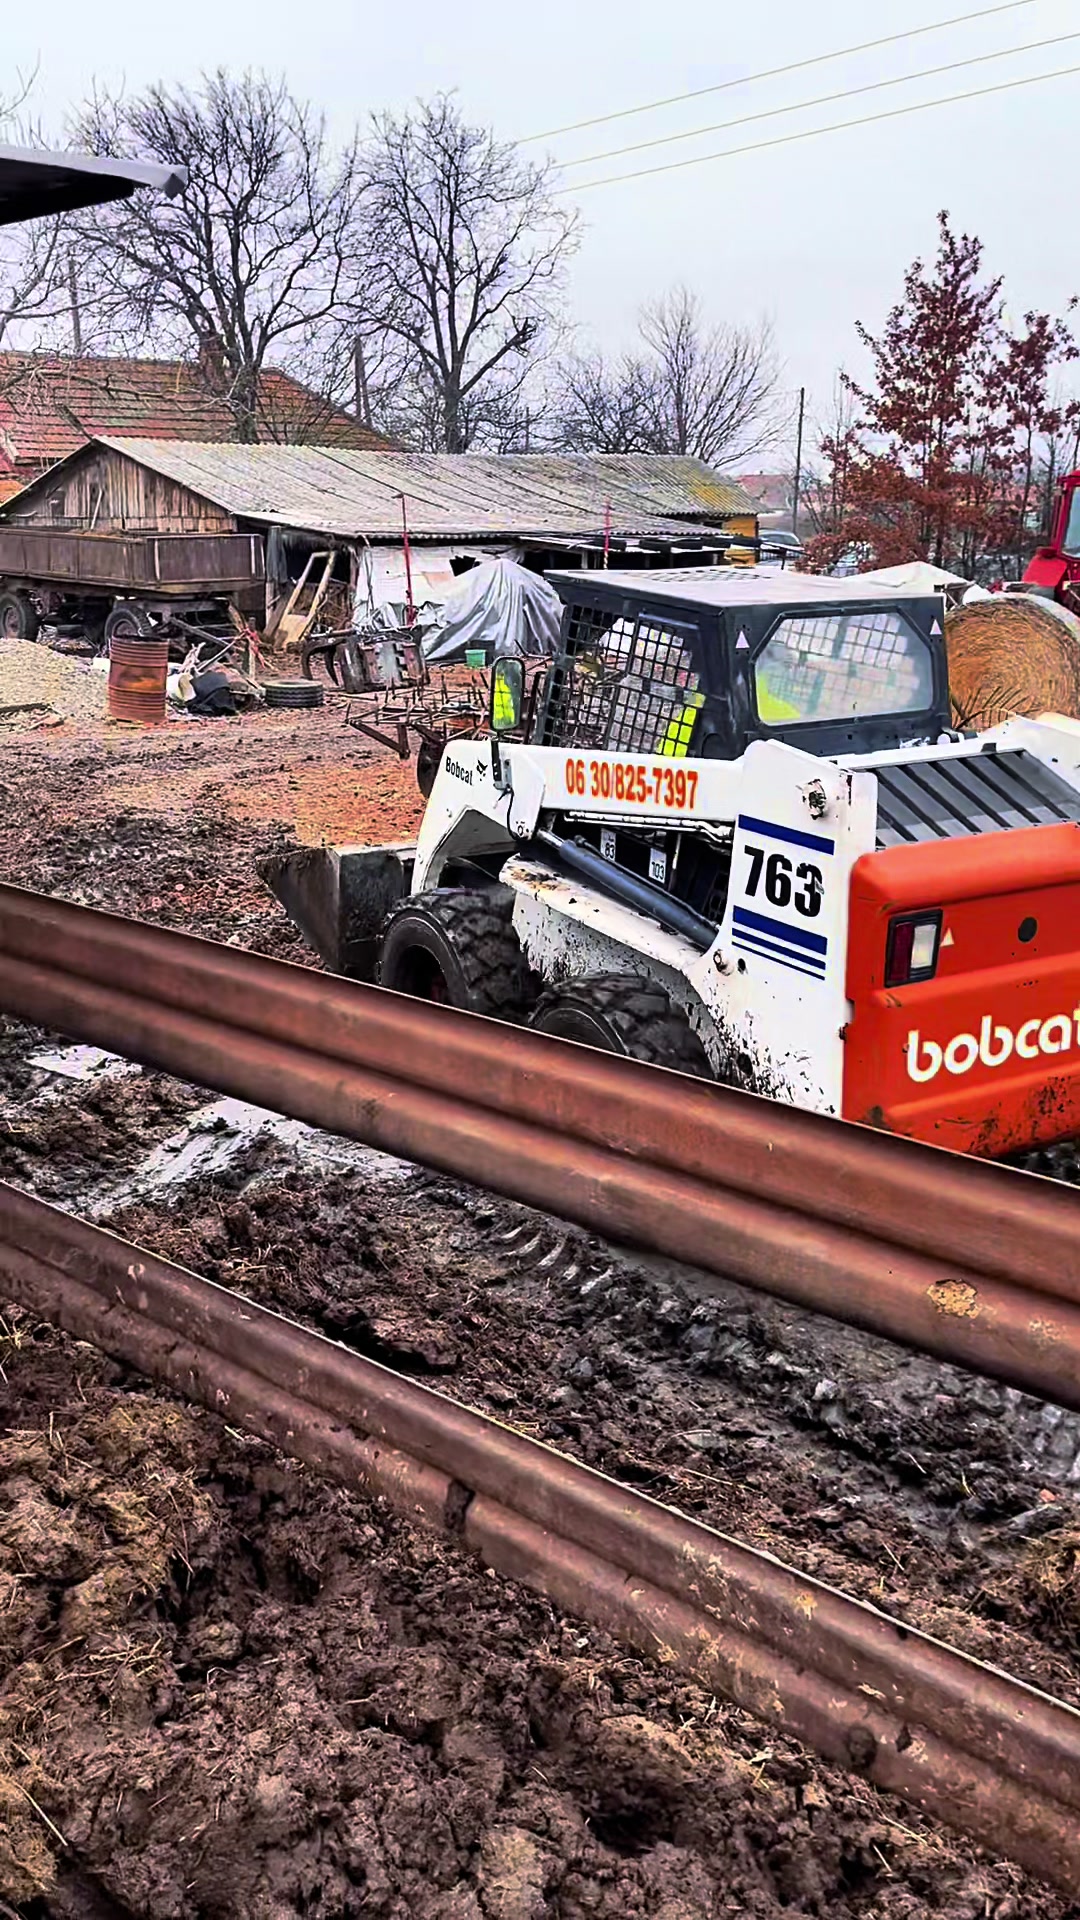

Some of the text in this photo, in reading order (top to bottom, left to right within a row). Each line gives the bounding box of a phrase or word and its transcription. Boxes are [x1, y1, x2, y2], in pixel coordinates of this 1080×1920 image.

[445, 755, 474, 786] Bobcat
[565, 758, 698, 809] 06 30/825-7397
[744, 844, 824, 917] 763
